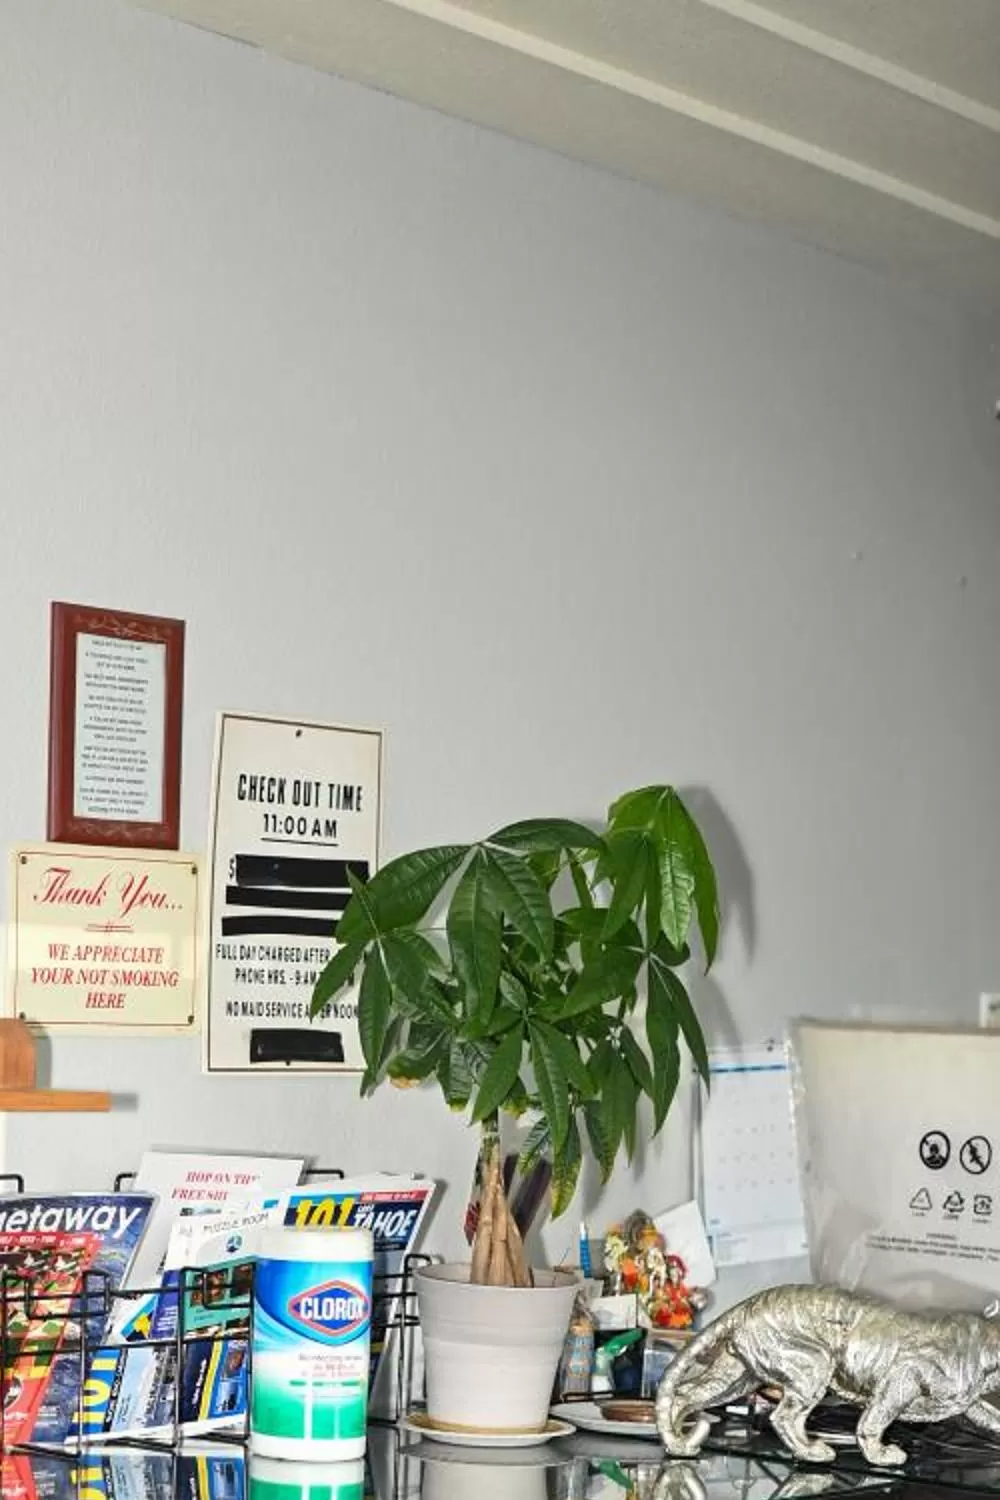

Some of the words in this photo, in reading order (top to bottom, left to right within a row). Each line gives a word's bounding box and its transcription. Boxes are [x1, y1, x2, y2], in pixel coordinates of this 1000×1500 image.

[237, 773, 287, 805] CHECK
[292, 779, 321, 808] OUT
[328, 783, 363, 812] TIME
[263, 813, 307, 835] 11:00
[311, 817, 338, 838] AM
[33, 867, 114, 906] Thank
[48, 943, 70, 961] WE
[72, 944, 164, 964] APPRECIATE
[215, 943, 237, 960] FULL
[239, 944, 256, 961] DAY
[258, 945, 301, 963] CHARGED
[303, 947, 330, 964] AFTER
[31, 967, 74, 985] YOUR
[76, 968, 109, 986] NOT
[111, 969, 180, 987] SMOKING
[235, 968, 265, 985] PHONE
[85, 991, 126, 1009] HERE
[226, 1001, 239, 1017] NO
[241, 1001, 265, 1017] MAID
[265, 1001, 303, 1018] SERVICE
[304, 1003, 360, 1019] AERNOON
[354, 1208, 418, 1237] TAHOE
